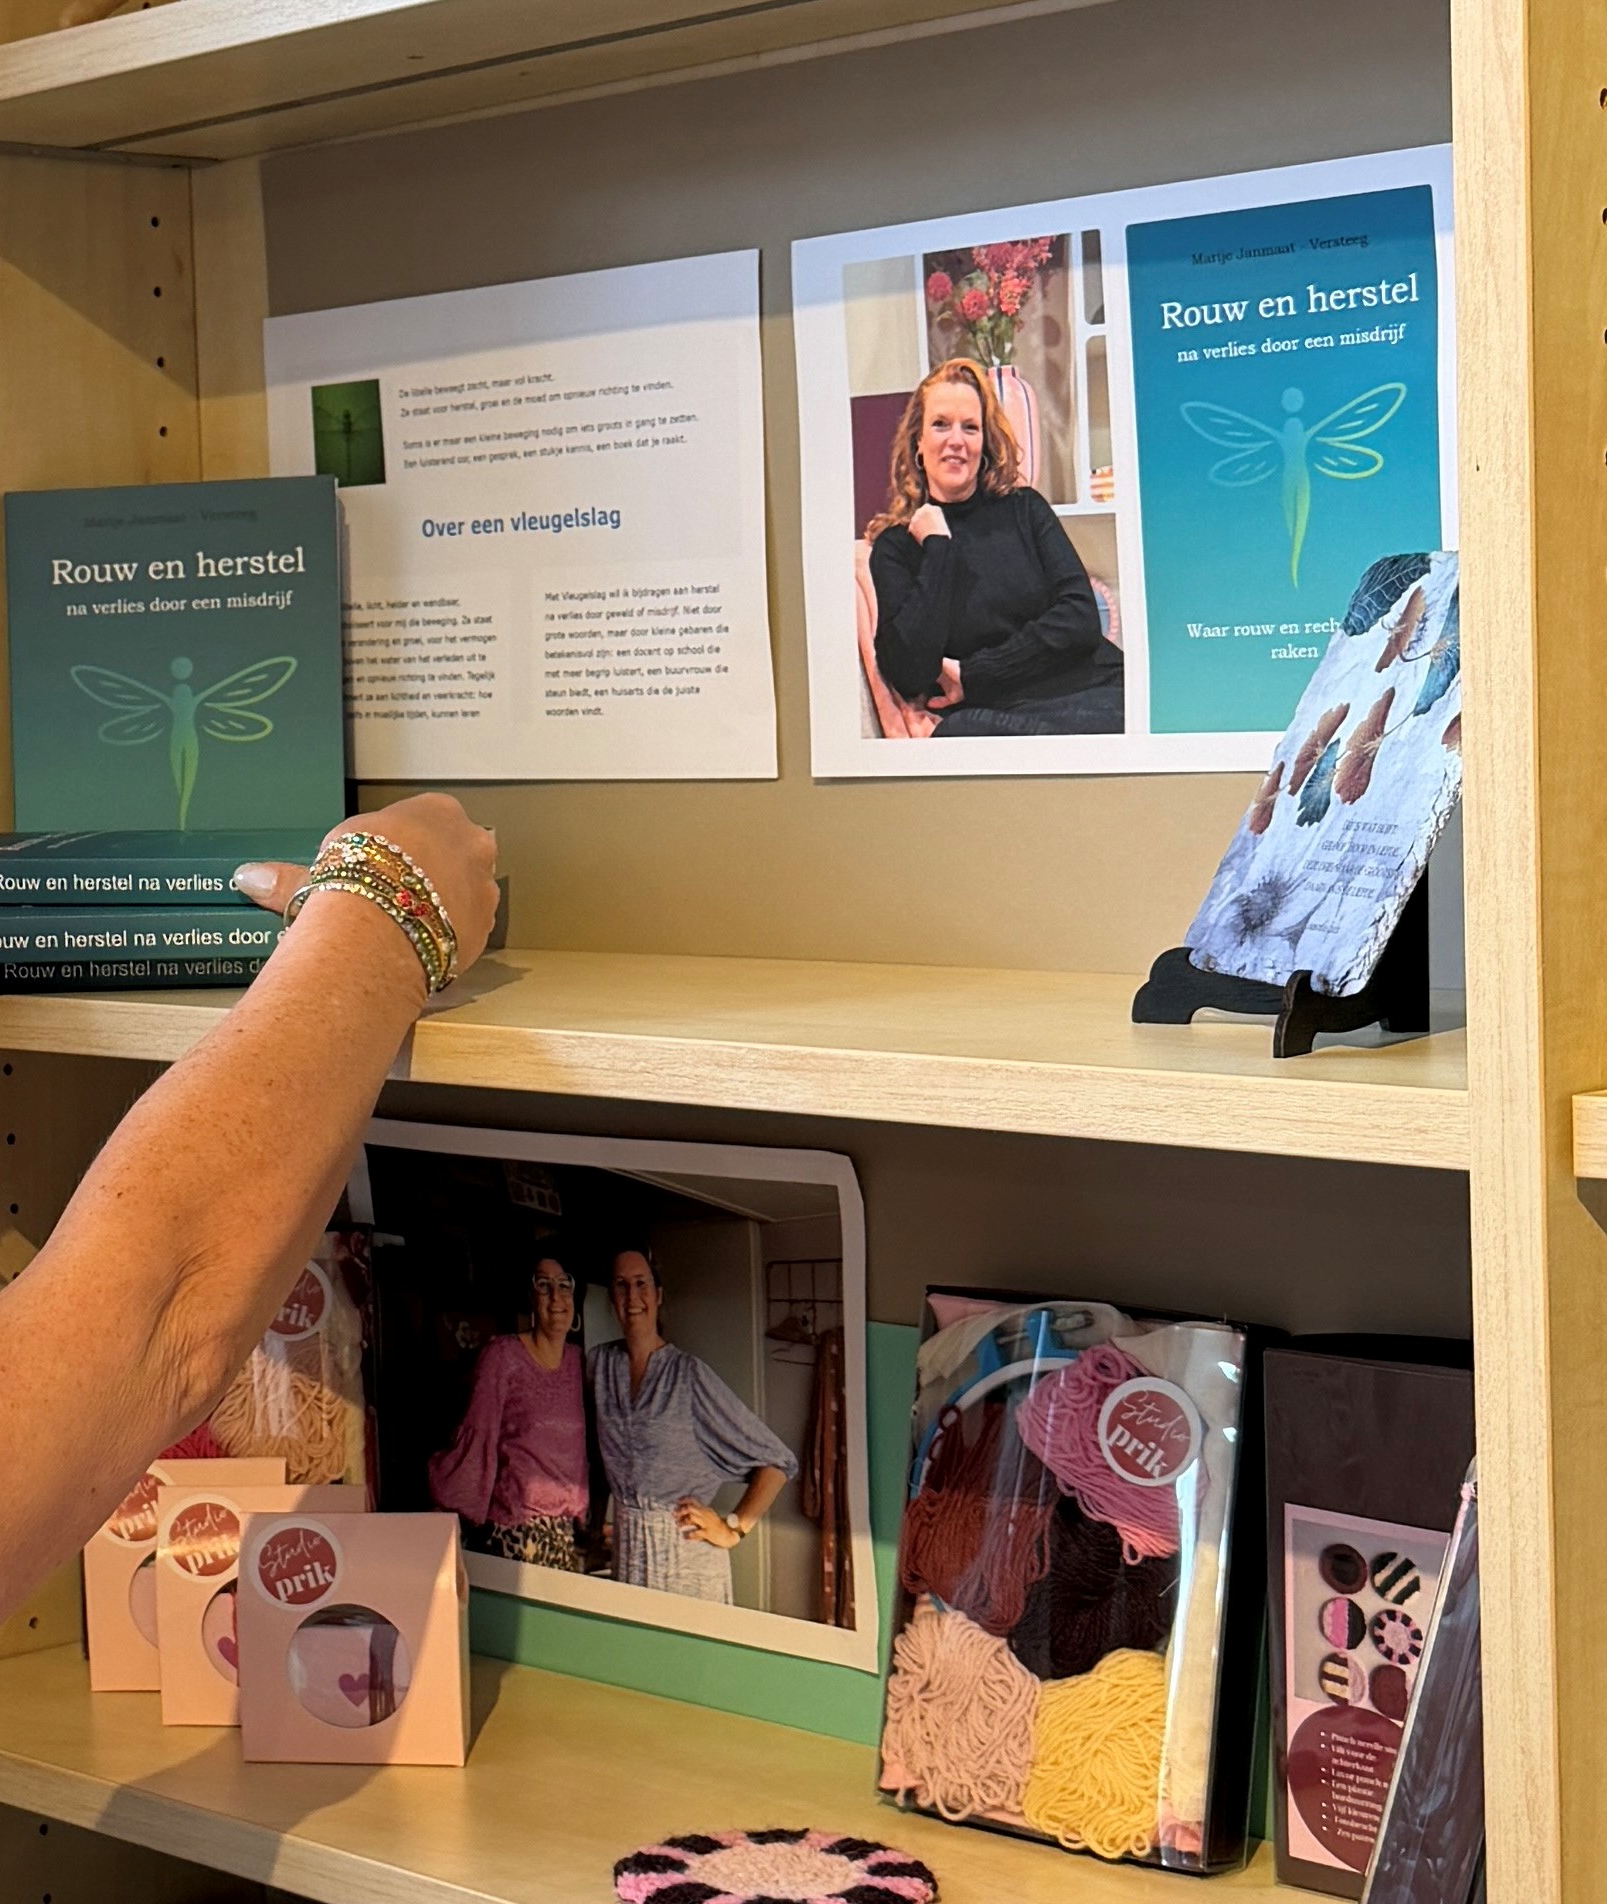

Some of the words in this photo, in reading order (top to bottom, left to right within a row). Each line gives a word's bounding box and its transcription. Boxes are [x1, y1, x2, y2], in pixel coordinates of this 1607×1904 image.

[1308, 234, 1368, 251] Versteeg
[1161, 300, 1248, 330] Rouw
[1258, 295, 1296, 318] en
[1307, 273, 1418, 313] herstel
[1177, 349, 1199, 363] na
[1202, 340, 1258, 360] verlies
[1260, 337, 1300, 354] door
[1304, 335, 1335, 349] een
[1339, 322, 1407, 346] misdrijf
[421, 518, 466, 538] Over
[470, 518, 505, 535] een
[510, 506, 621, 534] vleugelslag
[52, 559, 138, 585] Rouw
[148, 560, 185, 580] en
[196, 547, 305, 577] herstel
[66, 604, 88, 616] na
[92, 598, 146, 615] verlies
[149, 596, 188, 612] door
[191, 597, 222, 610] een
[226, 590, 293, 610] misdrijf
[1186, 623, 1230, 638] Waar
[1233, 624, 1276, 637] rouw
[1279, 623, 1300, 635] en
[1304, 617, 1341, 634] rech
[1270, 643, 1319, 659] raken
[46, 877, 68, 891] en
[73, 873, 133, 891] herstel
[138, 877, 161, 891] na
[165, 873, 224, 891] verlies
[34, 934, 59, 949] en
[64, 929, 128, 948] herstel
[133, 933, 157, 947] na
[162, 928, 224, 946] verlies
[228, 927, 272, 945] door
[278, 1303, 314, 1328] rik
[1107, 1423, 1169, 1478] prik
[259, 1528, 323, 1578] Studio
[275, 1560, 334, 1603] prik
